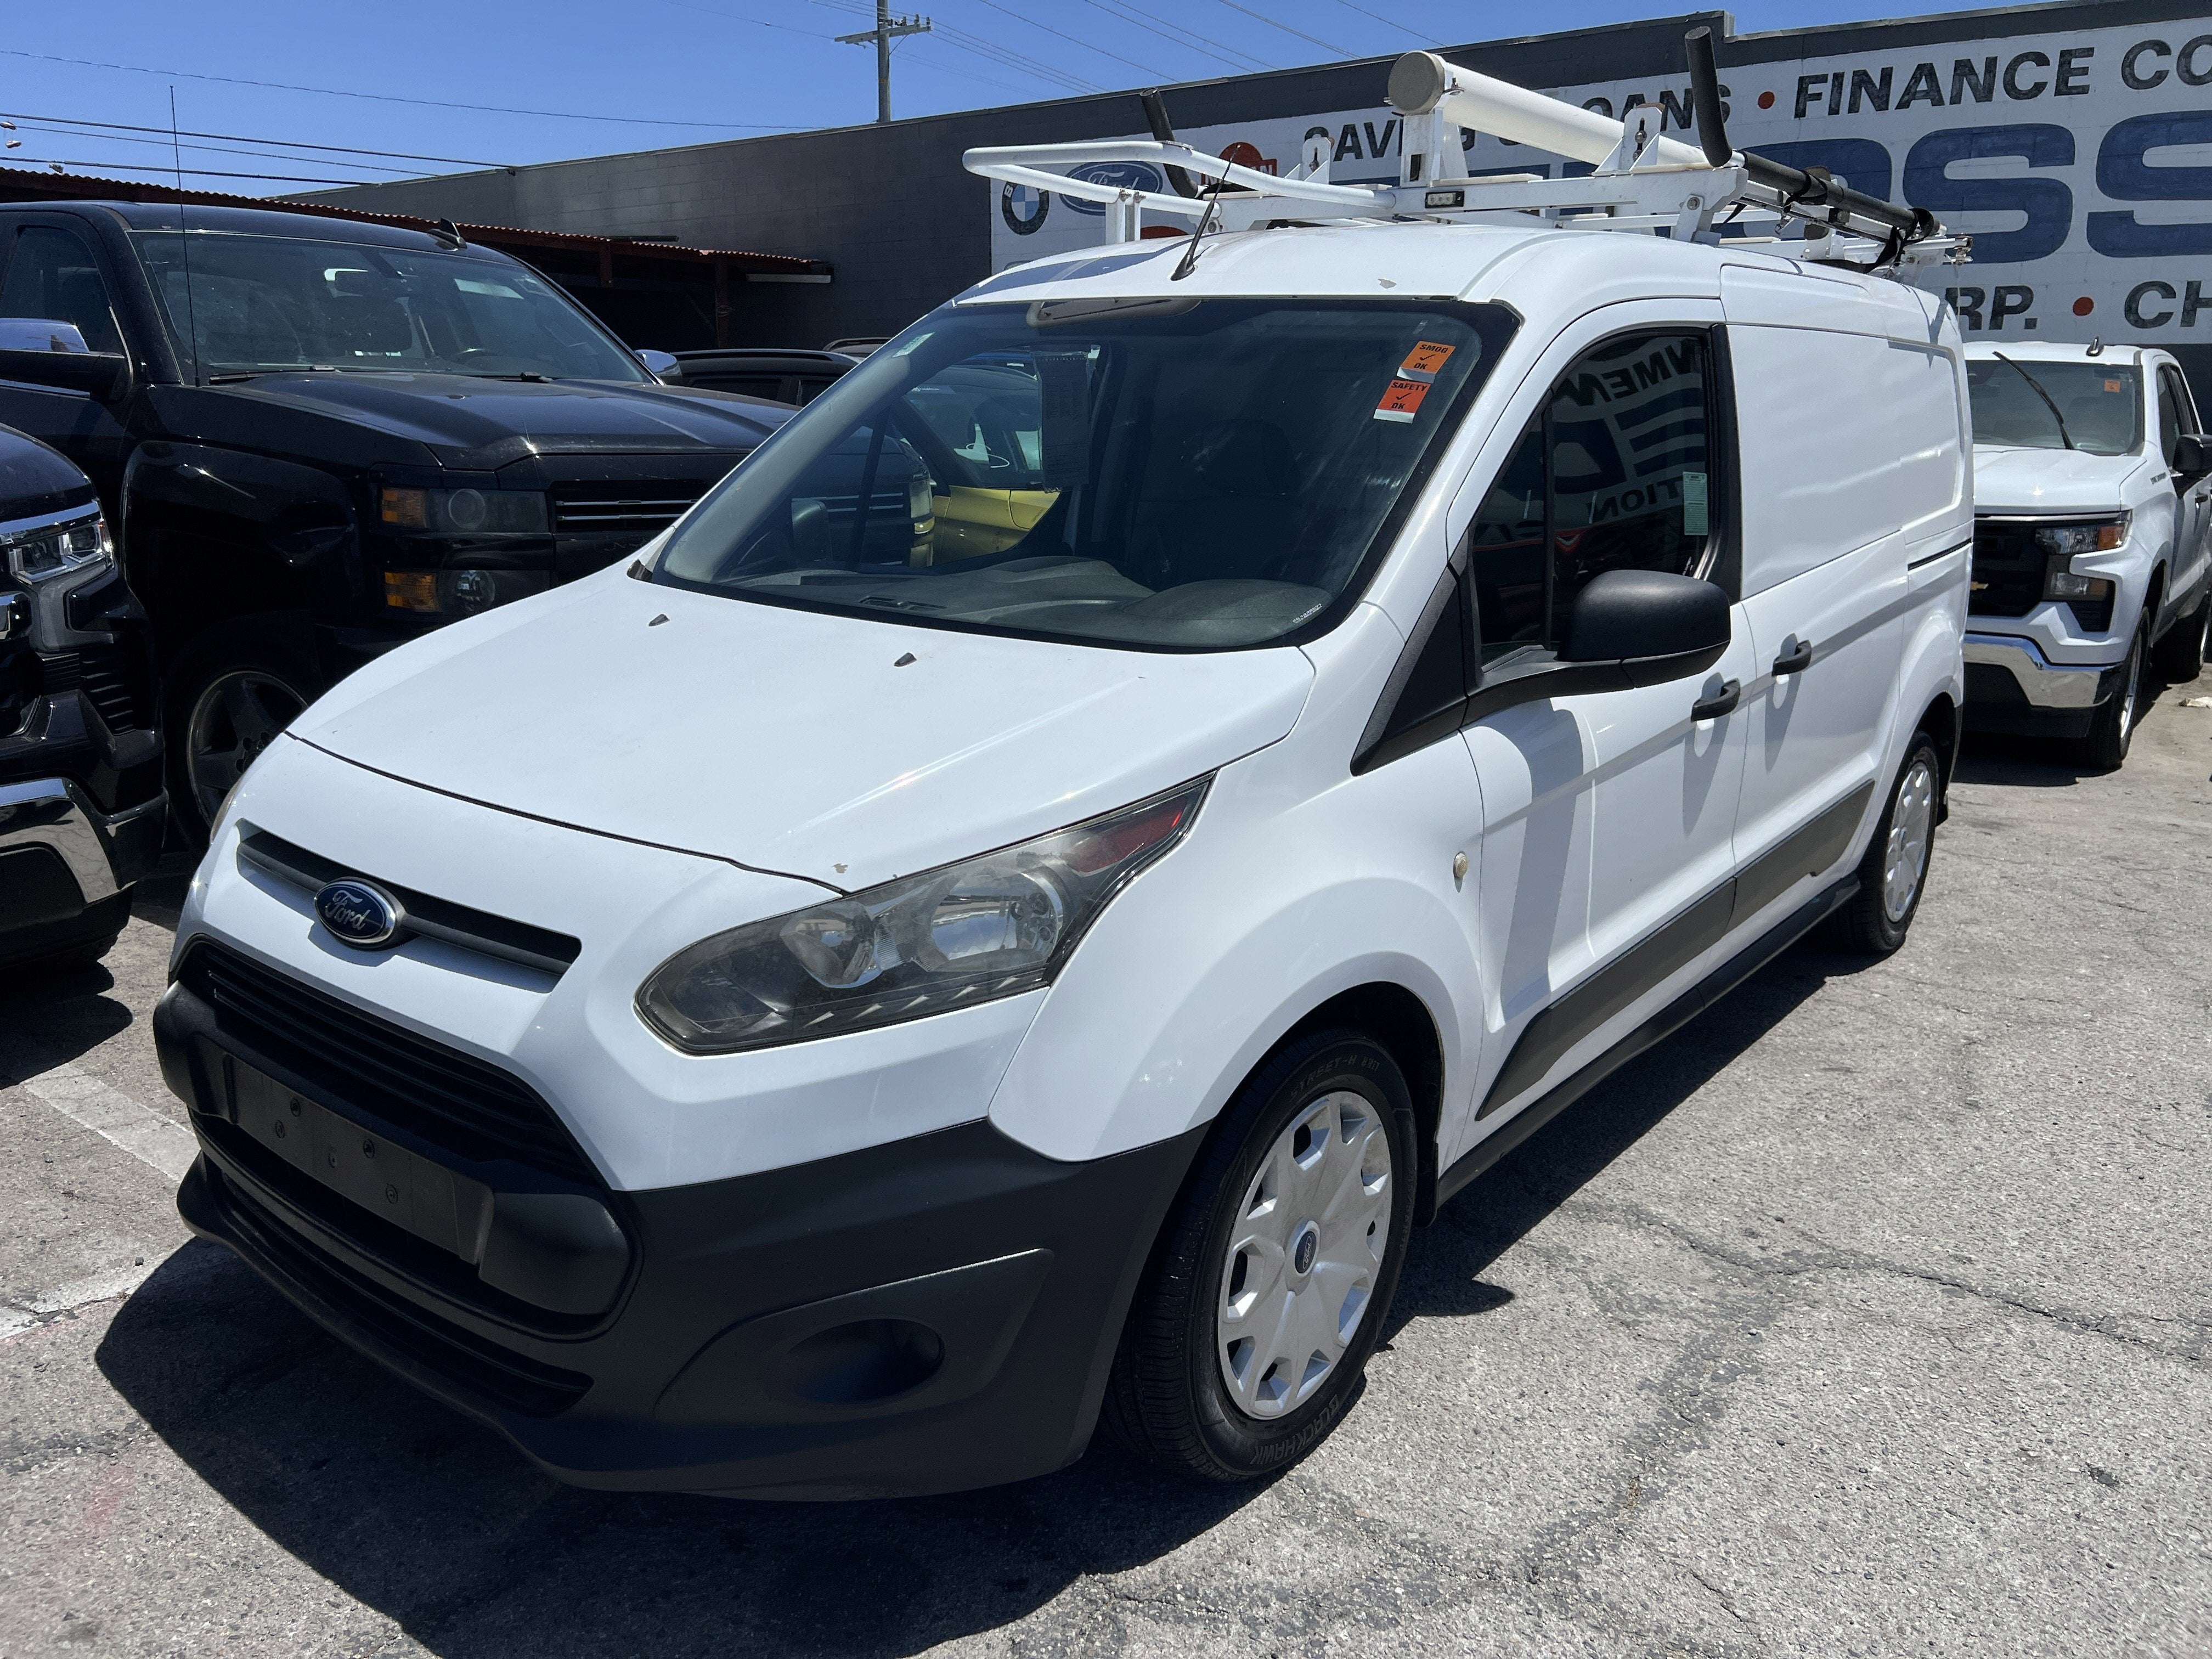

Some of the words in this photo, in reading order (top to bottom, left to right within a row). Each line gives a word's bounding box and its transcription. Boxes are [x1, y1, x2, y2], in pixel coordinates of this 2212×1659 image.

[1794, 47, 2095, 119] FINANCE
[1419, 344, 1448, 354] SMOG
[1391, 382, 1427, 391] SAFETY
[325, 890, 371, 930] Ford
[1250, 1394, 1339, 1465] BLACKHAWK
